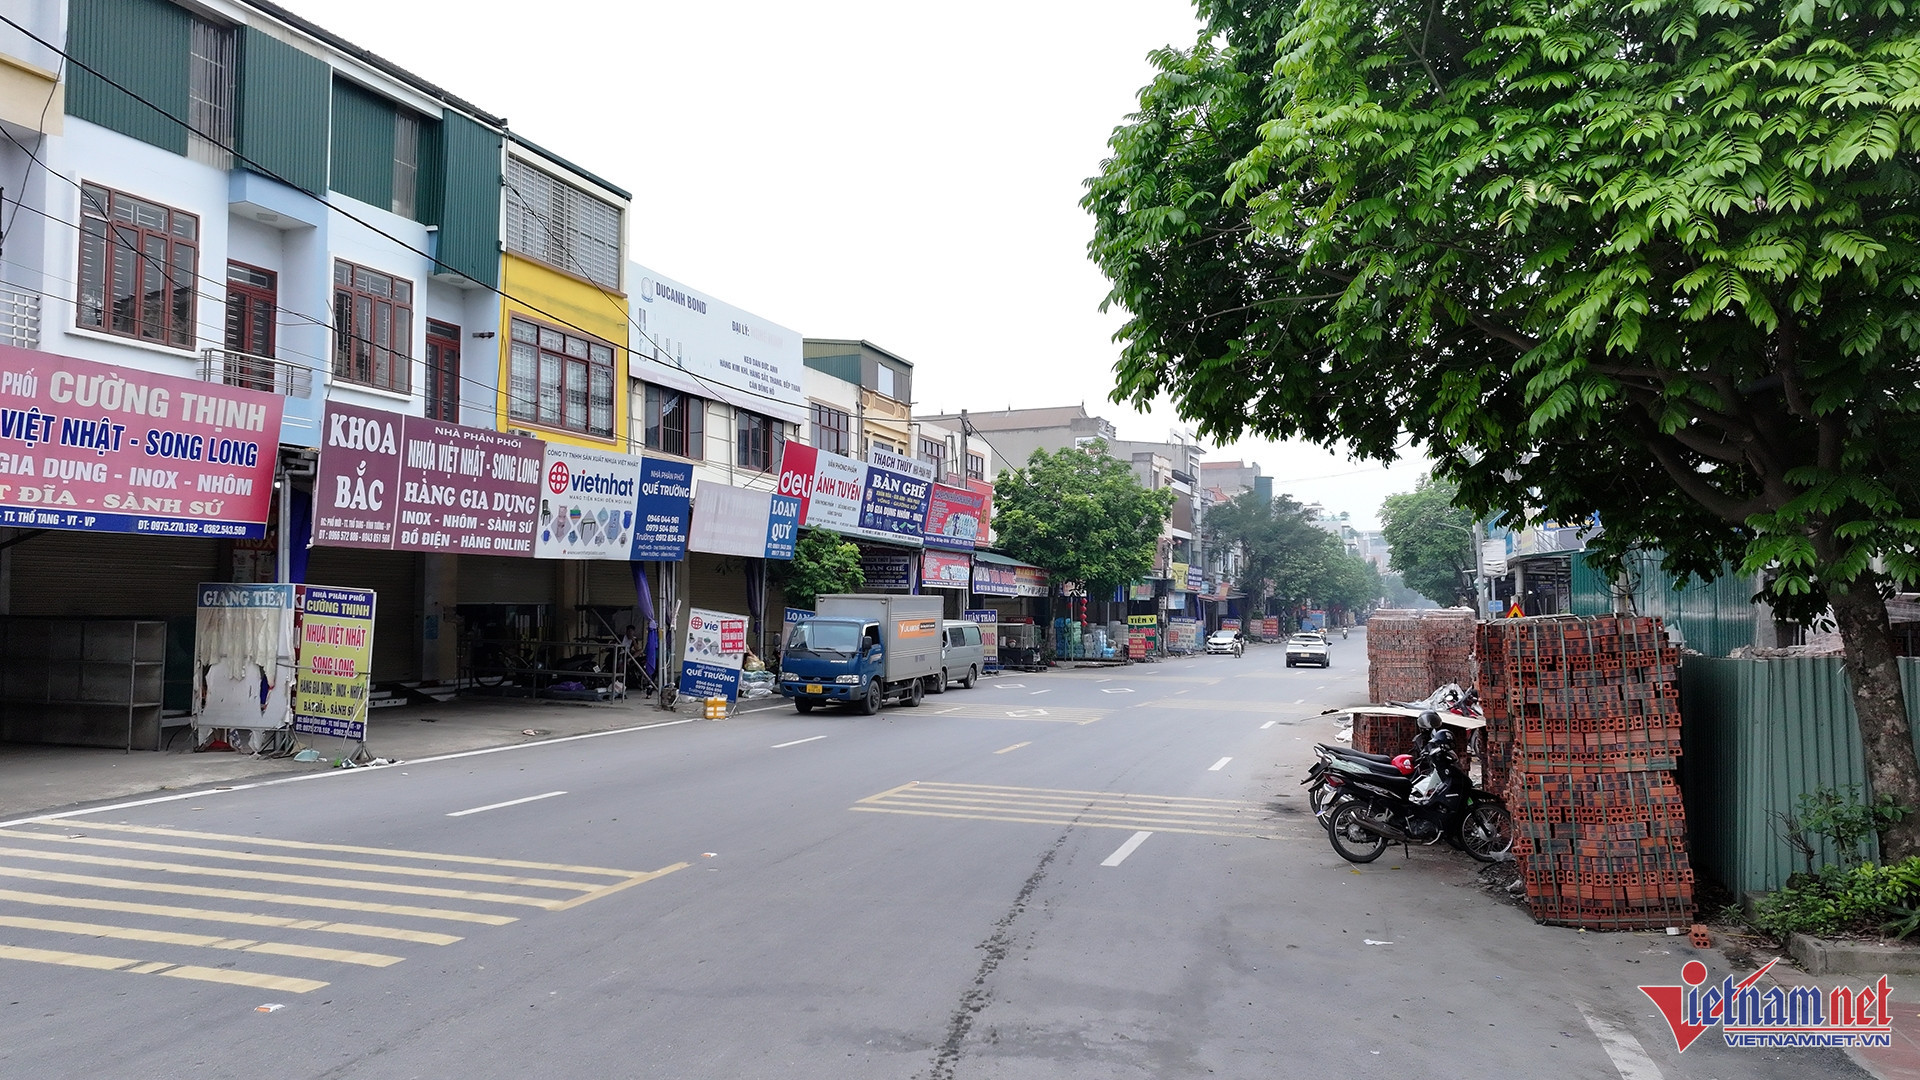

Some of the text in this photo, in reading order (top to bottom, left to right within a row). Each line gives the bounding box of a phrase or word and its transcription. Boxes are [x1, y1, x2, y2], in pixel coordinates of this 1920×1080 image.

[656, 282, 707, 315] DUCANH BOND
[2, 368, 267, 433] PHỐI CƯỜNG THỊNH
[1, 408, 258, 468] VIỆT NHẬT - SONG LONG
[328, 413, 396, 455] KHOA
[435, 426, 522, 448] NHÀ PHÂN PHỐI
[408, 440, 539, 485] NHỰA VIỆT NHẬT SONG LONG
[547, 449, 561, 457] CÔNG
[874, 453, 896, 468] THẠCH
[43, 459, 108, 484] DỤNG
[129, 467, 178, 490] INOX
[197, 473, 253, 496] NHÔM
[334, 460, 384, 511] BẮC
[571, 469, 634, 497] vietnhat
[642, 479, 690, 498] QUẾ TRƯỜNG
[780, 470, 813, 498] deli
[816, 471, 836, 496] ÁNH
[837, 477, 861, 501] TUYẾN
[872, 474, 901, 492] BÀN
[902, 483, 928, 499] GHẾ
[18, 484, 77, 505] ĐĨA
[103, 491, 182, 513] SÀNH
[189, 500, 224, 515] SỨ
[404, 480, 536, 519] HÀNG GIA DỤNG
[772, 500, 797, 518] LOAN
[37, 513, 59, 524] TANG
[67, 515, 78, 525] VT
[85, 517, 96, 526] VP
[151, 521, 198, 533] 0975.270.152
[402, 511, 431, 526] INOX
[443, 513, 477, 529] NHÔM
[487, 516, 516, 533] SÀNH
[518, 517, 533, 534] SỨ
[771, 521, 792, 541] QUÝ
[401, 527, 419, 545] ĐỒ
[421, 530, 450, 549] ĐIỆN
[461, 532, 492, 549] HÀNG
[494, 537, 531, 551] ONLINE
[203, 589, 250, 606] GIANG
[307, 599, 339, 614] CƯỜNG
[341, 603, 370, 617] THỊNH
[328, 592, 347, 600] PHÂN
[328, 623, 344, 648] VIỆT
[345, 625, 366, 651] NHẬT
[312, 656, 355, 677] SONG LONG
[686, 668, 703, 676] QUẾ
[704, 671, 735, 682] TRƯỜNG
